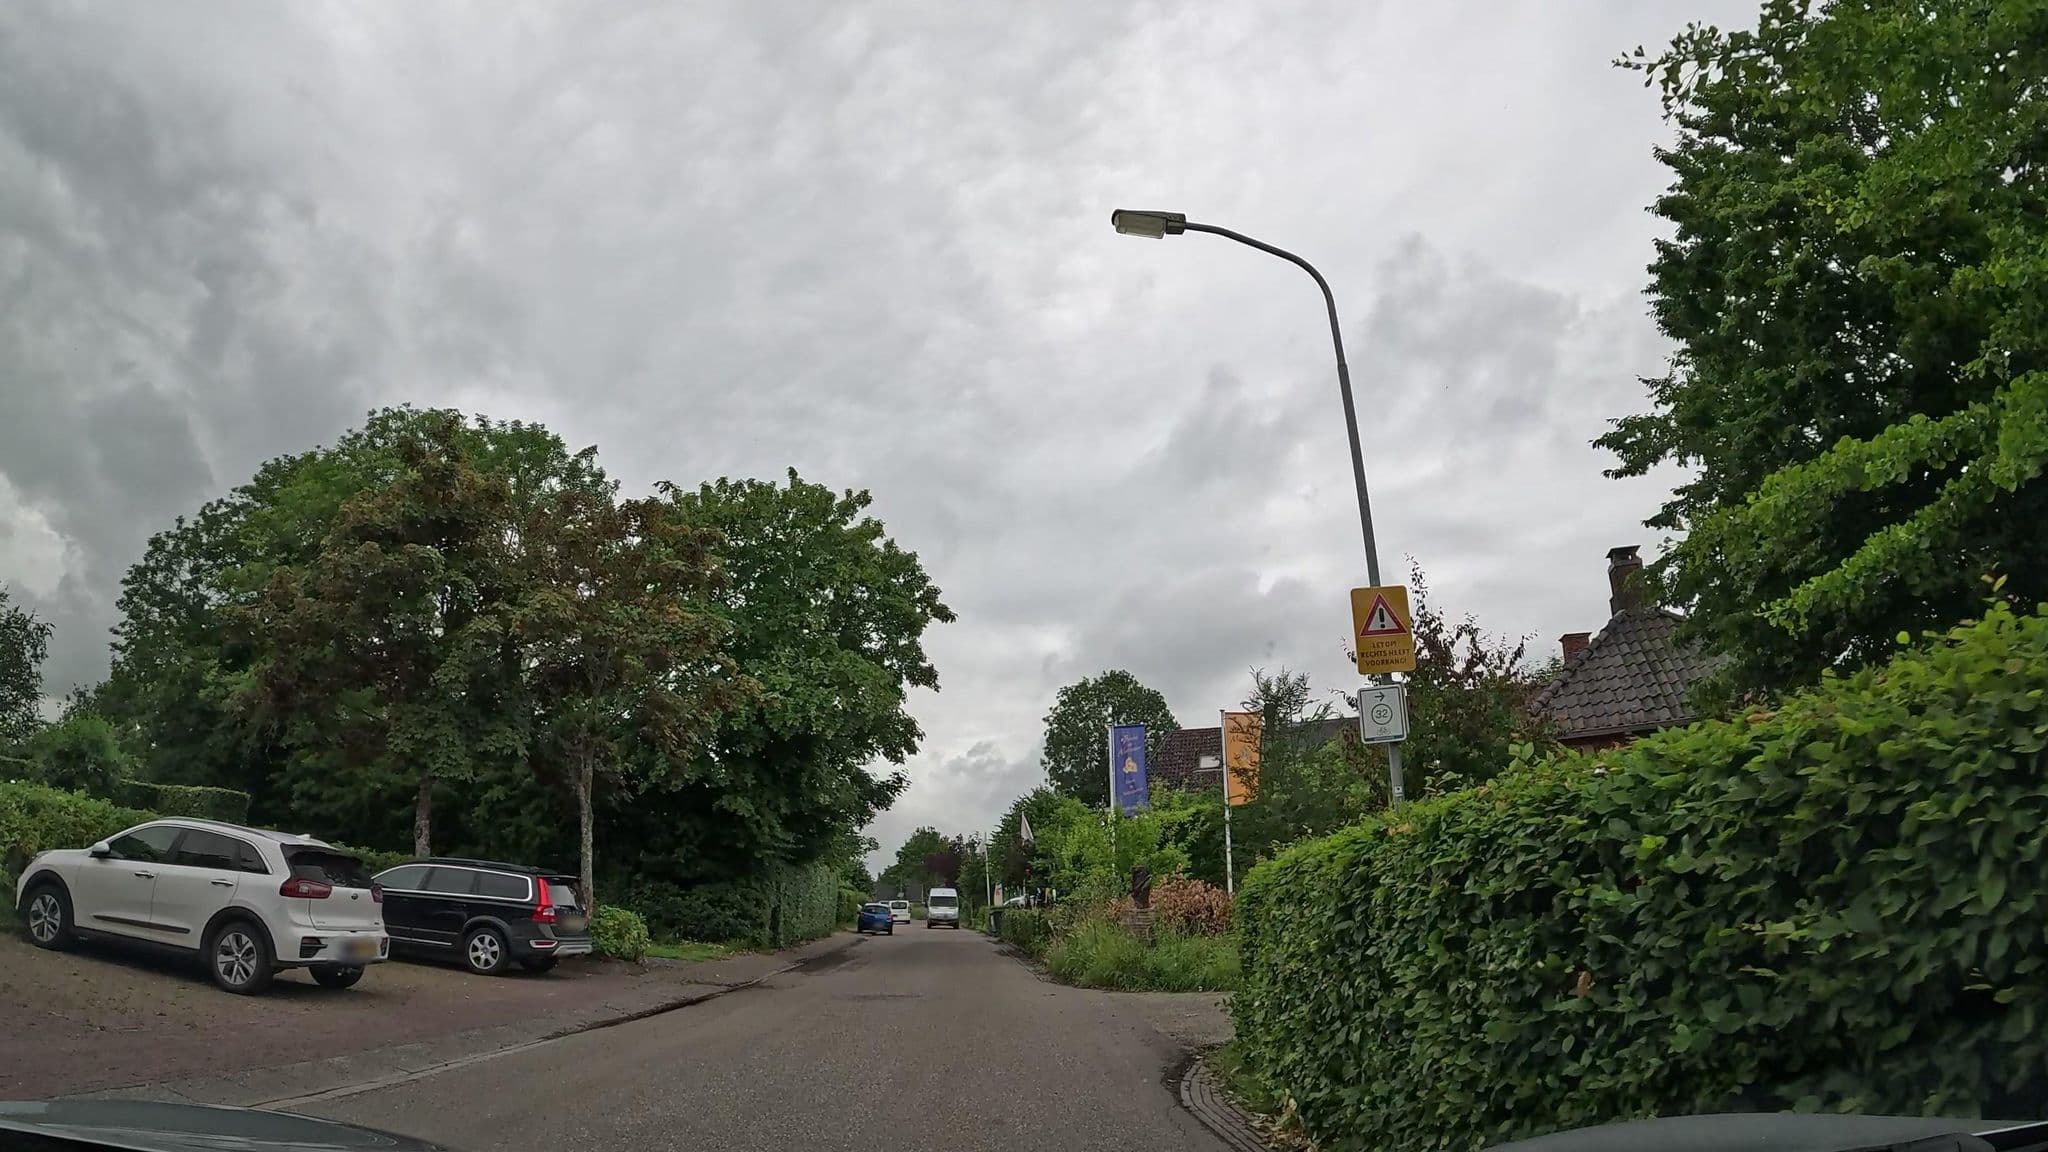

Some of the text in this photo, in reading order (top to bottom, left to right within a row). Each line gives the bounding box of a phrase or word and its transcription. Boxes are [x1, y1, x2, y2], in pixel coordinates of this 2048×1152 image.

[1360, 650, 1388, 658] RECHTS
[1365, 656, 1407, 666] VOORRANG!
[1375, 708, 1389, 719] 32
